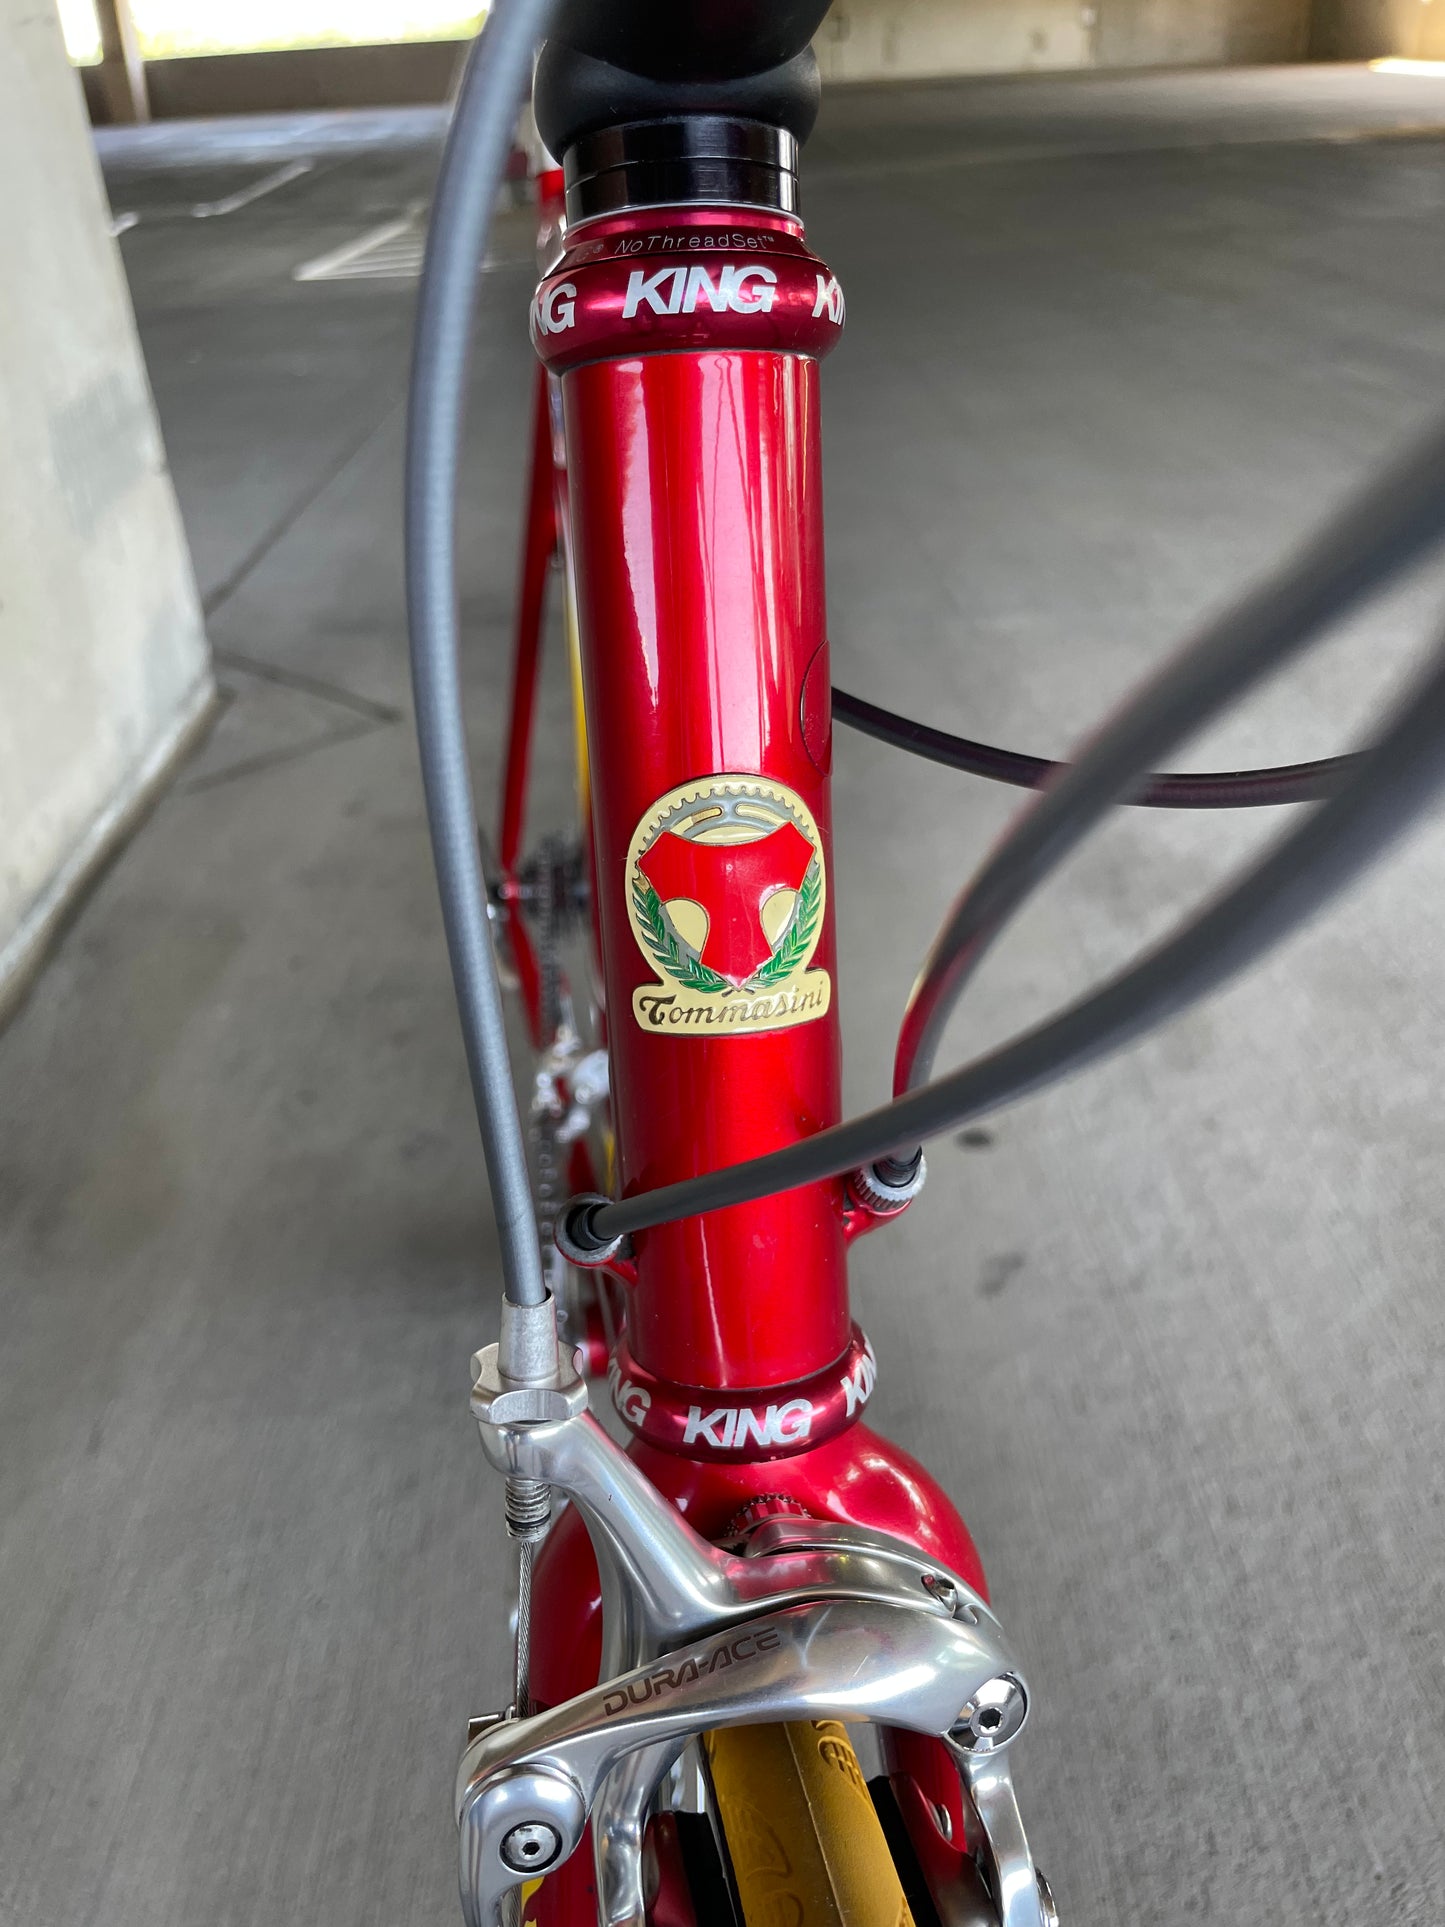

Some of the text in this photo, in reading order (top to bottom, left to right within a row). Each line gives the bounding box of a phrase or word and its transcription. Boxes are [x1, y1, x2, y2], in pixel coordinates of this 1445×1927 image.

[529, 283, 576, 344] NG
[622, 266, 777, 318] KING
[640, 982, 823, 1025] Tommasini
[608, 1357, 651, 1427] NG
[840, 1334, 877, 1417] KIN
[683, 1398, 812, 1448] KING
[602, 1626, 781, 1716] DURA-ACE
